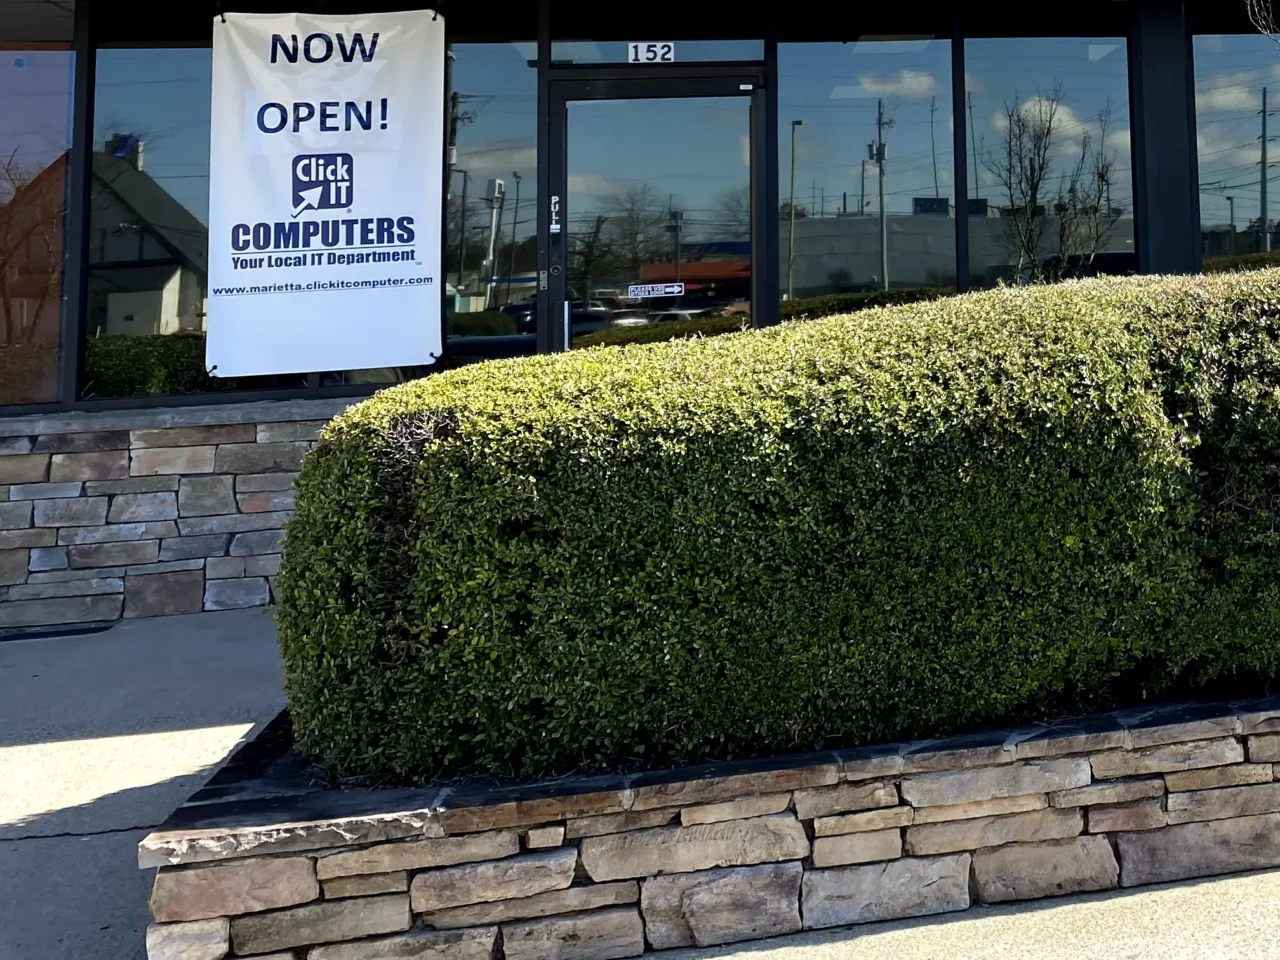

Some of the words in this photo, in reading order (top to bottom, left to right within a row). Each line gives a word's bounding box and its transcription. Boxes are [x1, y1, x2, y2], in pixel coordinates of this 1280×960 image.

[269, 32, 380, 64] NOW
[631, 43, 673, 63] 152
[256, 98, 389, 134] OPEN!
[296, 155, 350, 182] Click
[329, 181, 351, 206] IT
[231, 216, 416, 252] COMPUTERS
[231, 256, 265, 270] Your
[267, 253, 307, 268] Local
[310, 252, 324, 266] IT
[327, 248, 416, 266] Department
[212, 275, 434, 295] www.marietta.clickitcomputer.com
